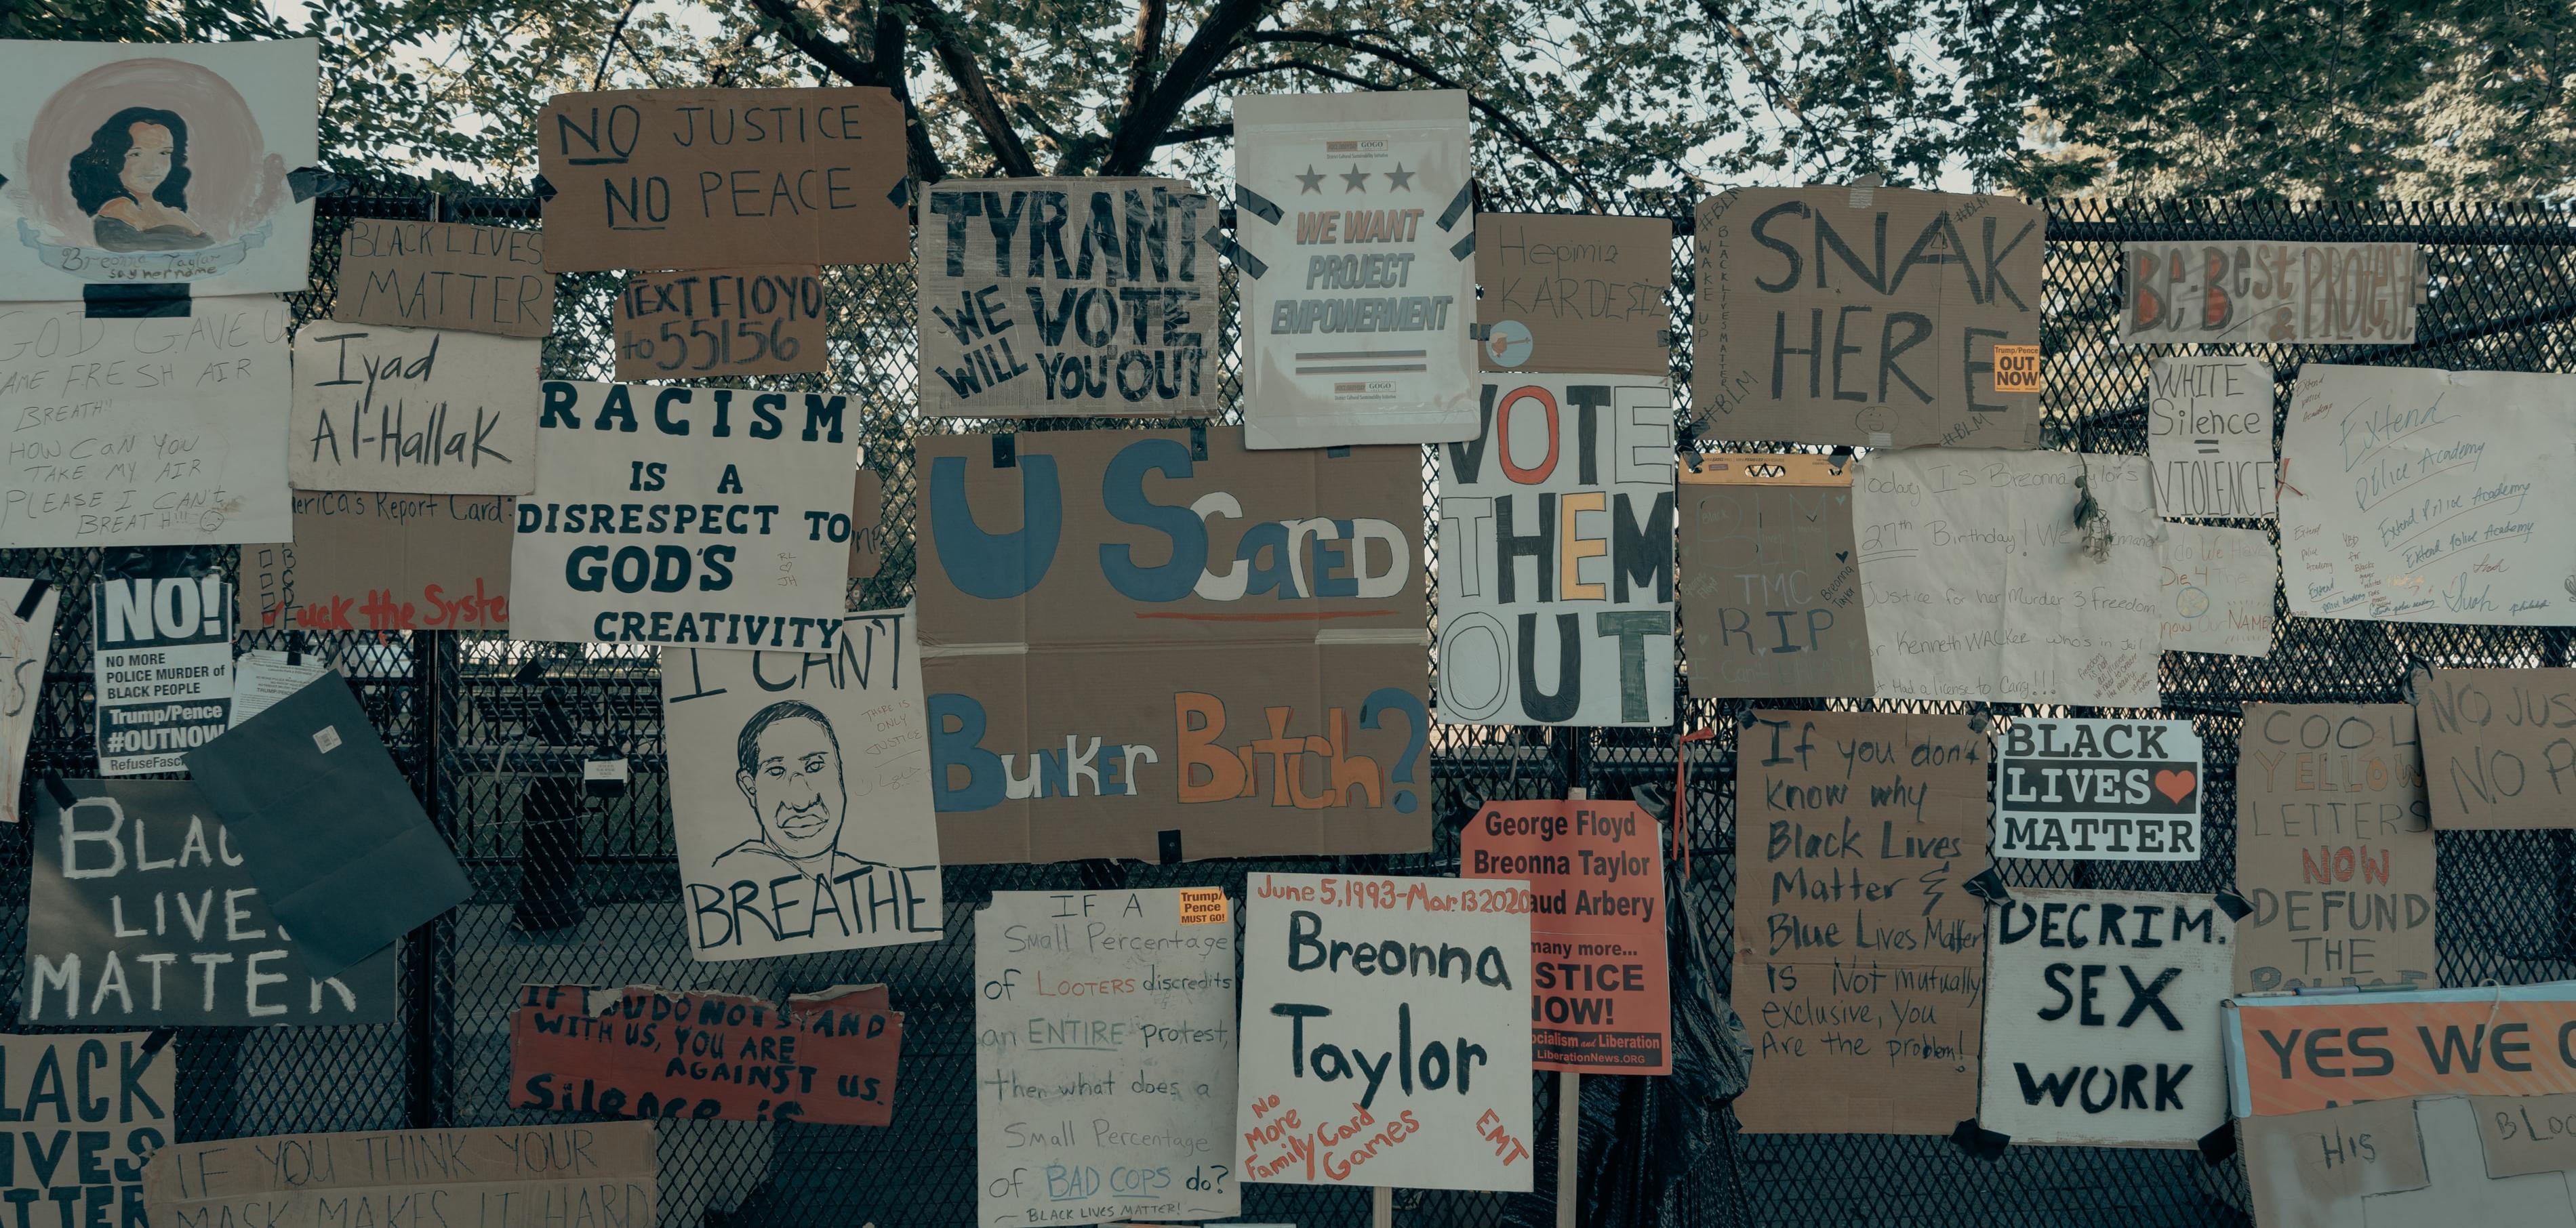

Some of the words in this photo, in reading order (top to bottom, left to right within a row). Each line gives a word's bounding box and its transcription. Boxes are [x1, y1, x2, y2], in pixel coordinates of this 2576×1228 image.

[557, 104, 641, 157] NO
[672, 105, 862, 146] JUSTICE
[605, 176, 670, 228] NO
[700, 167, 856, 218] PEACE
[350, 221, 433, 257] BLACK
[446, 225, 542, 264] LIVES
[930, 186, 1207, 283] TYRANT
[1297, 210, 1340, 245] WE
[1344, 209, 1424, 243] WANT
[1306, 253, 1415, 289] PROJECT
[1750, 199, 2036, 312] SNAK
[359, 268, 542, 327] MATTER
[624, 275, 703, 319] TEXT
[931, 284, 1014, 346] WE
[1026, 287, 1201, 348] VOTE
[1272, 295, 1453, 334] EMPOWERMENT
[134, 310, 249, 354] GAVE
[622, 329, 653, 359] to
[656, 316, 800, 371] 55156
[196, 358, 252, 386] AIR
[314, 333, 439, 413] Iyad
[935, 337, 1028, 400] WILL
[1035, 352, 1107, 400] YOU
[1116, 348, 1207, 402] OUT
[1997, 371, 2038, 386] NOW
[2000, 356, 2034, 370] OUT
[2149, 363, 2247, 399] WHITE
[540, 381, 847, 443] RACISM
[2151, 398, 2261, 435] Silence
[9, 441, 61, 465] HOW
[153, 433, 199, 462] YOU
[1449, 384, 1673, 486] VOTE
[23, 465, 86, 483] TAKE
[106, 462, 136, 483] MY
[155, 459, 201, 483] AIR
[629, 461, 667, 491] IS
[717, 464, 743, 493] A
[2150, 461, 2275, 516] VIOLENCE
[376, 492, 437, 525] Report
[517, 504, 778, 535] DISRESPECT
[804, 511, 851, 543] TO
[930, 453, 1062, 600] U
[1441, 491, 1674, 605] THEM
[566, 544, 736, 594] GOD'S
[1734, 570, 1811, 607] TMC
[104, 574, 222, 642] NO!
[594, 611, 843, 649] CREATIVITY
[1718, 607, 1834, 655] RIP
[106, 655, 125, 668] NO
[129, 653, 165, 666] MORE
[106, 668, 152, 684] POLICE
[156, 666, 209, 680] MURDER
[212, 664, 226, 677] of
[1438, 611, 1671, 724] OUT
[107, 686, 149, 699] BLACK
[154, 682, 201, 697] PEOPLE
[2429, 680, 2491, 735] NO
[109, 704, 222, 726] Trump/Pence
[2264, 710, 2416, 749] COOL
[1761, 720, 1815, 771] If
[1837, 738, 1895, 778] you
[1912, 737, 1979, 766] don't
[2005, 723, 2168, 758] BLACK
[2007, 767, 2151, 804] LIVES
[2253, 749, 2423, 792] YELLOW
[2450, 747, 2525, 814] NO
[1872, 776, 1928, 822] why
[1486, 811, 1568, 842] George
[1577, 810, 1636, 843] Floyd
[1767, 817, 1863, 863] Black
[1881, 820, 1962, 859] Lives
[2003, 818, 2194, 853] MATTER
[2253, 801, 2431, 840] LETTERS
[1474, 849, 1570, 876] Breonna
[1579, 850, 1650, 882] Taylor
[2302, 845, 2389, 886] NOW
[1051, 894, 1098, 917] IF
[1123, 893, 1142, 918] A
[1181, 891, 1222, 902] Trump/
[1257, 875, 1314, 901] June
[1772, 867, 1909, 906] Matter
[685, 865, 943, 951] BREATHE
[1182, 914, 1205, 922] MUST
[1207, 914, 1225, 922] GO!
[1184, 903, 1220, 913] Pence
[1575, 891, 1654, 922] Arbery
[2000, 899, 2226, 948] DECRIM.
[2253, 888, 2430, 933] DEFUND
[1005, 923, 1070, 953] Small
[1087, 922, 1228, 956] Percentage
[1288, 910, 1512, 990] Breonna
[1578, 941, 1637, 956] more...
[1767, 909, 1845, 955] Blue
[1857, 909, 1916, 949] Lives
[1833, 955, 1887, 994] Not
[2291, 938, 2375, 975] THE
[984, 968, 1021, 1001] of
[1037, 970, 1135, 996] LOOTERS
[1143, 964, 1231, 991] discredits
[2037, 962, 2184, 1030] SEX
[699, 997, 767, 1027] NOT
[535, 1013, 613, 1043] WITH
[625, 1023, 660, 1052] US,
[675, 1025, 724, 1059] YOU
[740, 1036, 795, 1064] ARE
[981, 1029, 1016, 1047] an
[1028, 1018, 1127, 1046] ENTIRE
[1599, 1037, 1659, 1049] Liberation
[1763, 1031, 1806, 1059] Are
[1821, 1035, 1871, 1057] the
[2258, 1027, 2394, 1080] YES
[2417, 1023, 2533, 1075] WE
[1270, 1001, 1487, 1109] Taylor
[1537, 1050, 1645, 1063] LiberationNews.ORG
[666, 1057, 816, 1094] AGAINST
[1059, 1068, 1115, 1096] what
[1131, 1069, 1179, 1095] does
[1196, 1086, 1210, 1097] a
[2013, 1062, 2194, 1113] WORK
[1252, 1094, 1280, 1118] No
[1005, 1120, 1074, 1148] Small
[1092, 1118, 1210, 1157] Percentage
[1476, 1108, 1529, 1166] EMT
[178, 1148, 228, 1200] IF
[256, 1137, 336, 1186] YOU
[357, 1132, 475, 1181] THINK
[496, 1129, 599, 1176] YOUR
[989, 1167, 1028, 1198] of
[1046, 1166, 1101, 1198] BAD
[1110, 1166, 1171, 1191] COPS
[1186, 1164, 1228, 1193] do?
[1026, 1206, 1075, 1223] BLACK
[1079, 1206, 1114, 1218] LIVES
[1121, 1202, 1181, 1216] MATTER!
